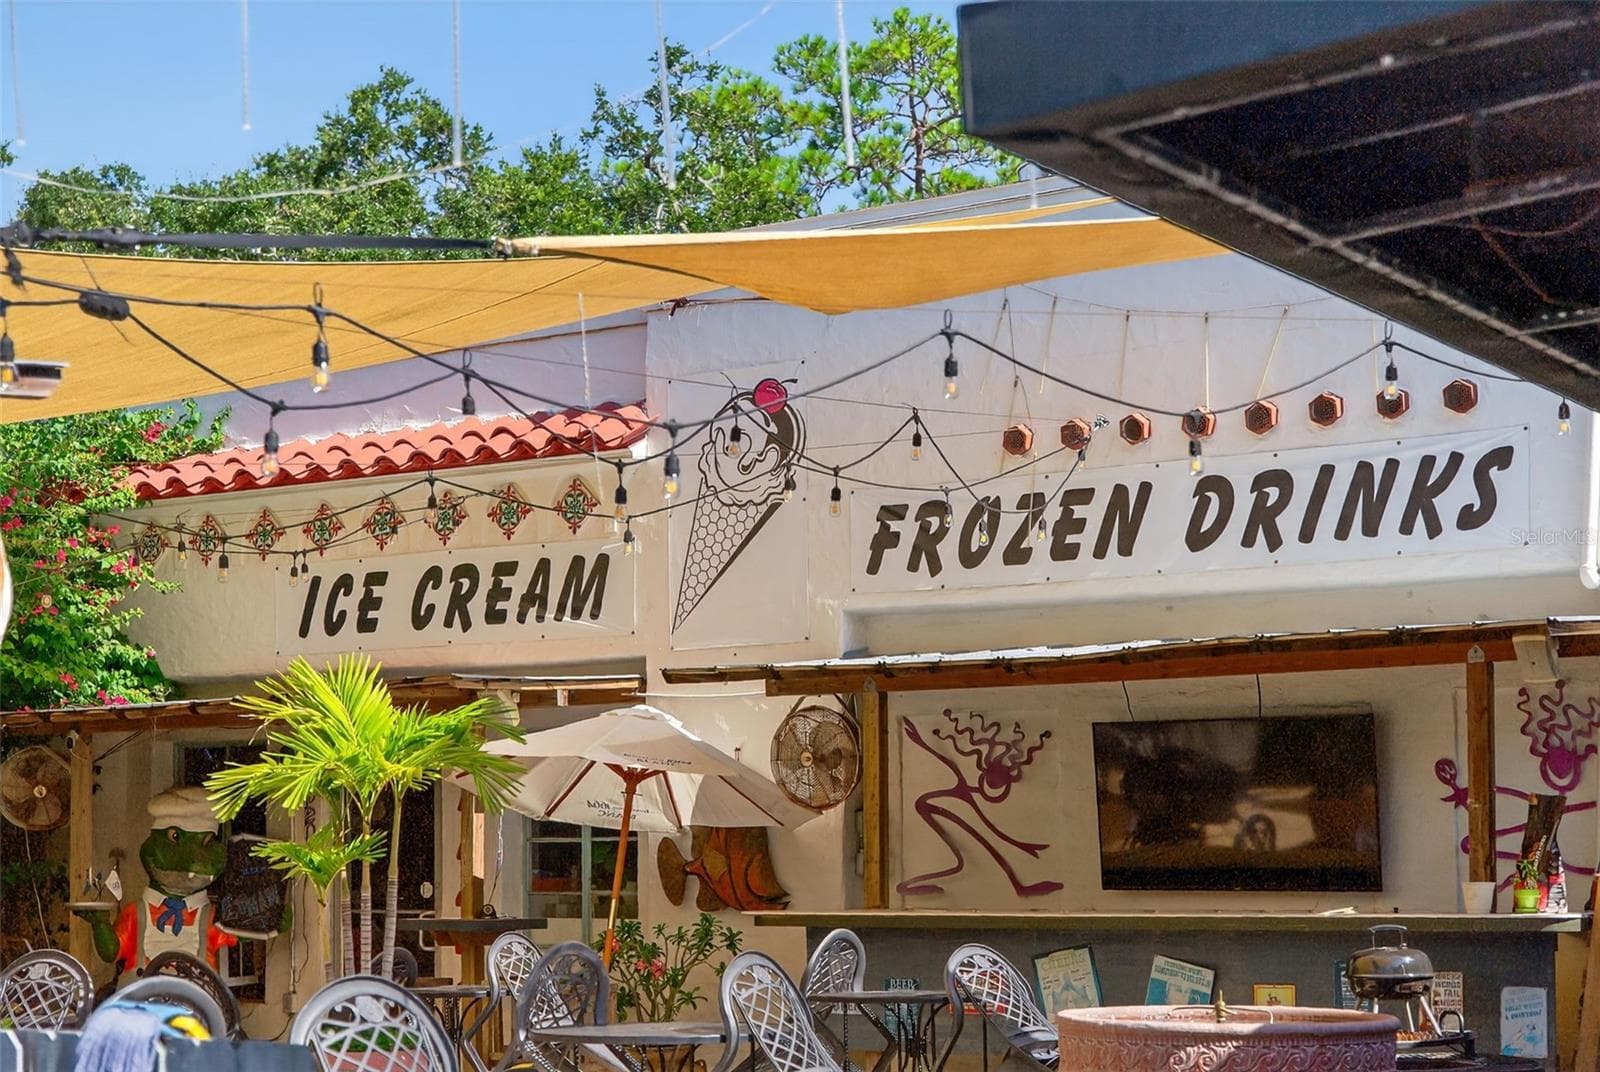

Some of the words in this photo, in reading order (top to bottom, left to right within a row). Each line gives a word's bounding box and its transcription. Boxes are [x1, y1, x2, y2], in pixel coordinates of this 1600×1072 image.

[865, 480, 1154, 577] FROZEN
[1184, 446, 1515, 555] DRINKS
[298, 571, 389, 638] ICE
[411, 553, 610, 633] CREAM
